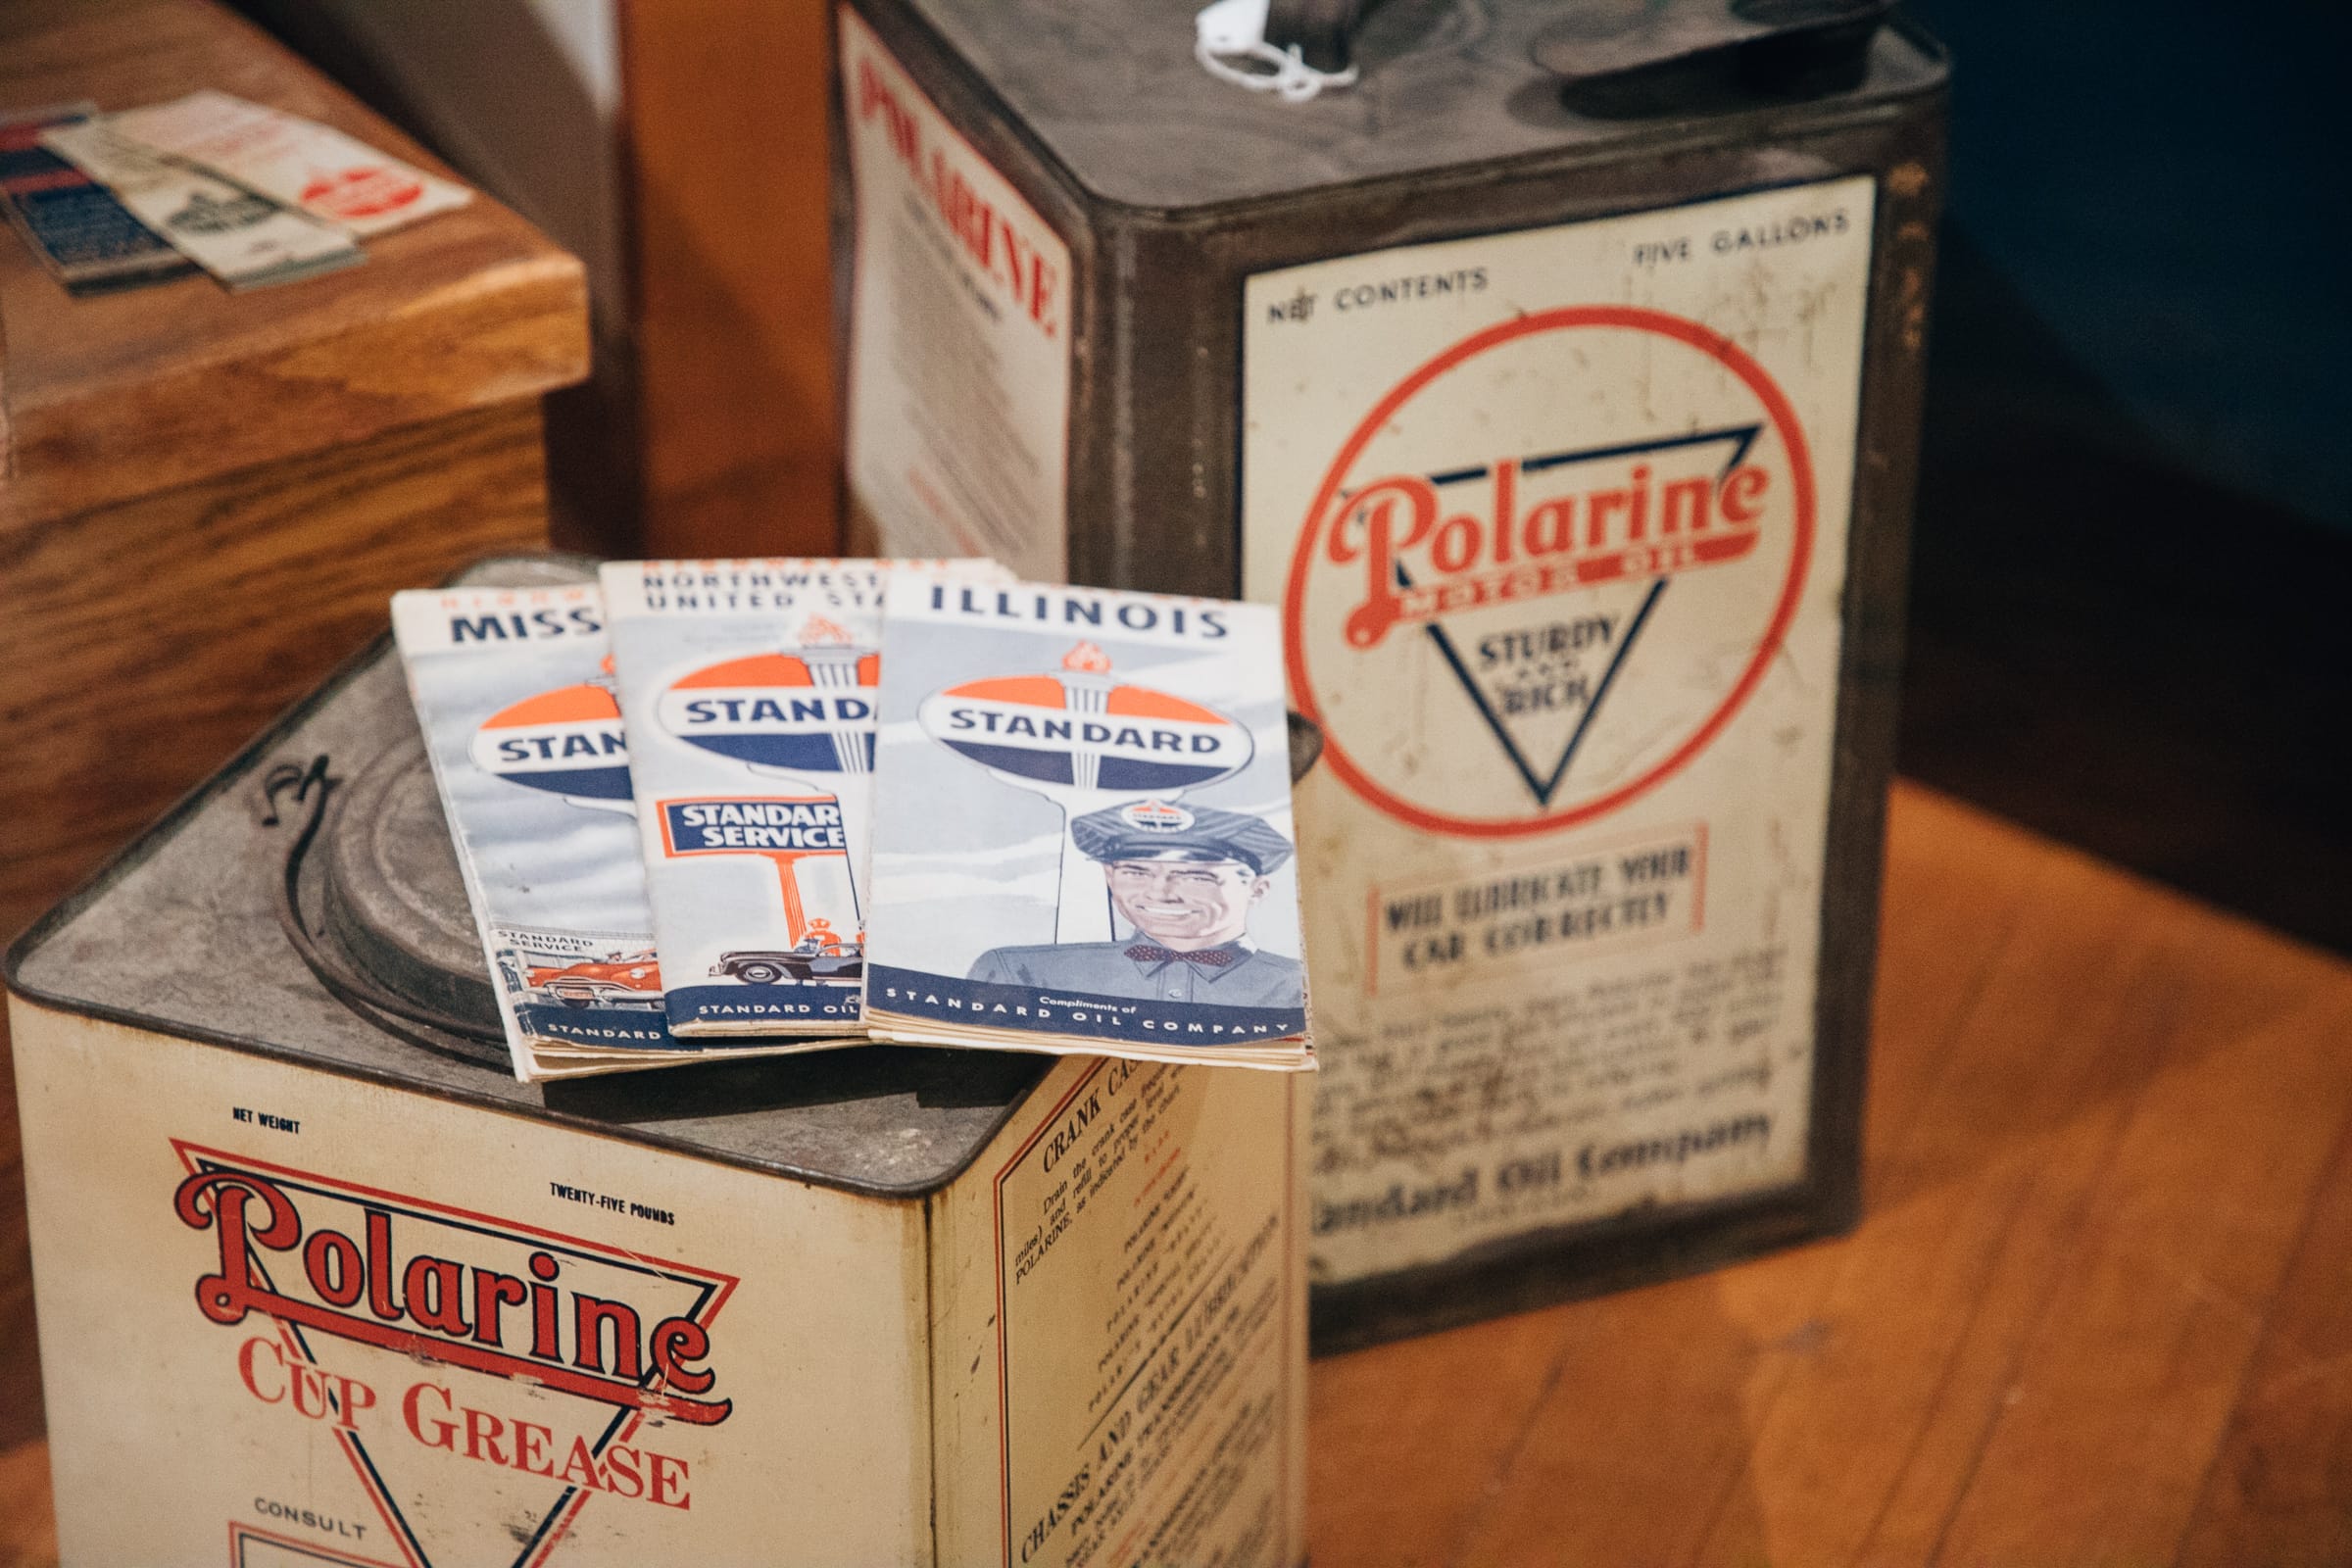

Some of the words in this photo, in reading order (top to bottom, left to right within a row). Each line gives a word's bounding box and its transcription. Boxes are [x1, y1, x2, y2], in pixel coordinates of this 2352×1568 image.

[1634, 240, 1691, 267] FIVE
[1713, 208, 1850, 257] GALLONS
[1266, 290, 1315, 321] NET
[1335, 267, 1489, 312] CONTENTS
[1326, 459, 1770, 651] Polarine
[647, 592, 793, 610] UNITED
[930, 585, 1229, 639] ILLINOIS
[451, 608, 603, 642] MISS
[1478, 615, 1617, 669] STURDY
[685, 699, 878, 723] STAND
[950, 709, 1221, 755] STANDARD
[498, 732, 627, 761] STAN
[682, 805, 840, 826] STANDAR
[702, 827, 847, 848] SERVICE
[497, 930, 594, 948] STANDARD
[509, 938, 582, 952] SERVICE
[699, 1004, 811, 1015] STANDARD
[823, 1004, 858, 1015] OIL
[886, 986, 1052, 1019] STANDARD
[1071, 1010, 1122, 1027] OIL
[1142, 1018, 1289, 1036] COMPANY
[1039, 996, 1119, 1013] Compliments
[1121, 1005, 1138, 1015] of
[548, 1023, 662, 1040] STANDARD
[232, 1107, 254, 1123] NET
[258, 1113, 301, 1135] WEIGHT
[1044, 1088, 1101, 1172] CRANK
[1108, 1058, 1143, 1096] CAS
[550, 1182, 626, 1214] TWENTY-FIVE
[629, 1202, 676, 1225] POUNDS
[1044, 1180, 1067, 1214] Drain
[1074, 1158, 1086, 1179] the
[1015, 1225, 1042, 1266] miles)
[1050, 1200, 1065, 1225] and
[1073, 1168, 1091, 1199] refill
[173, 1172, 733, 1427] Polarine
[237, 1336, 377, 1434] CUP
[402, 1383, 692, 1511] GREASE
[255, 1496, 368, 1542] CONSULT
[1021, 1462, 1090, 1563] CHASSIS
